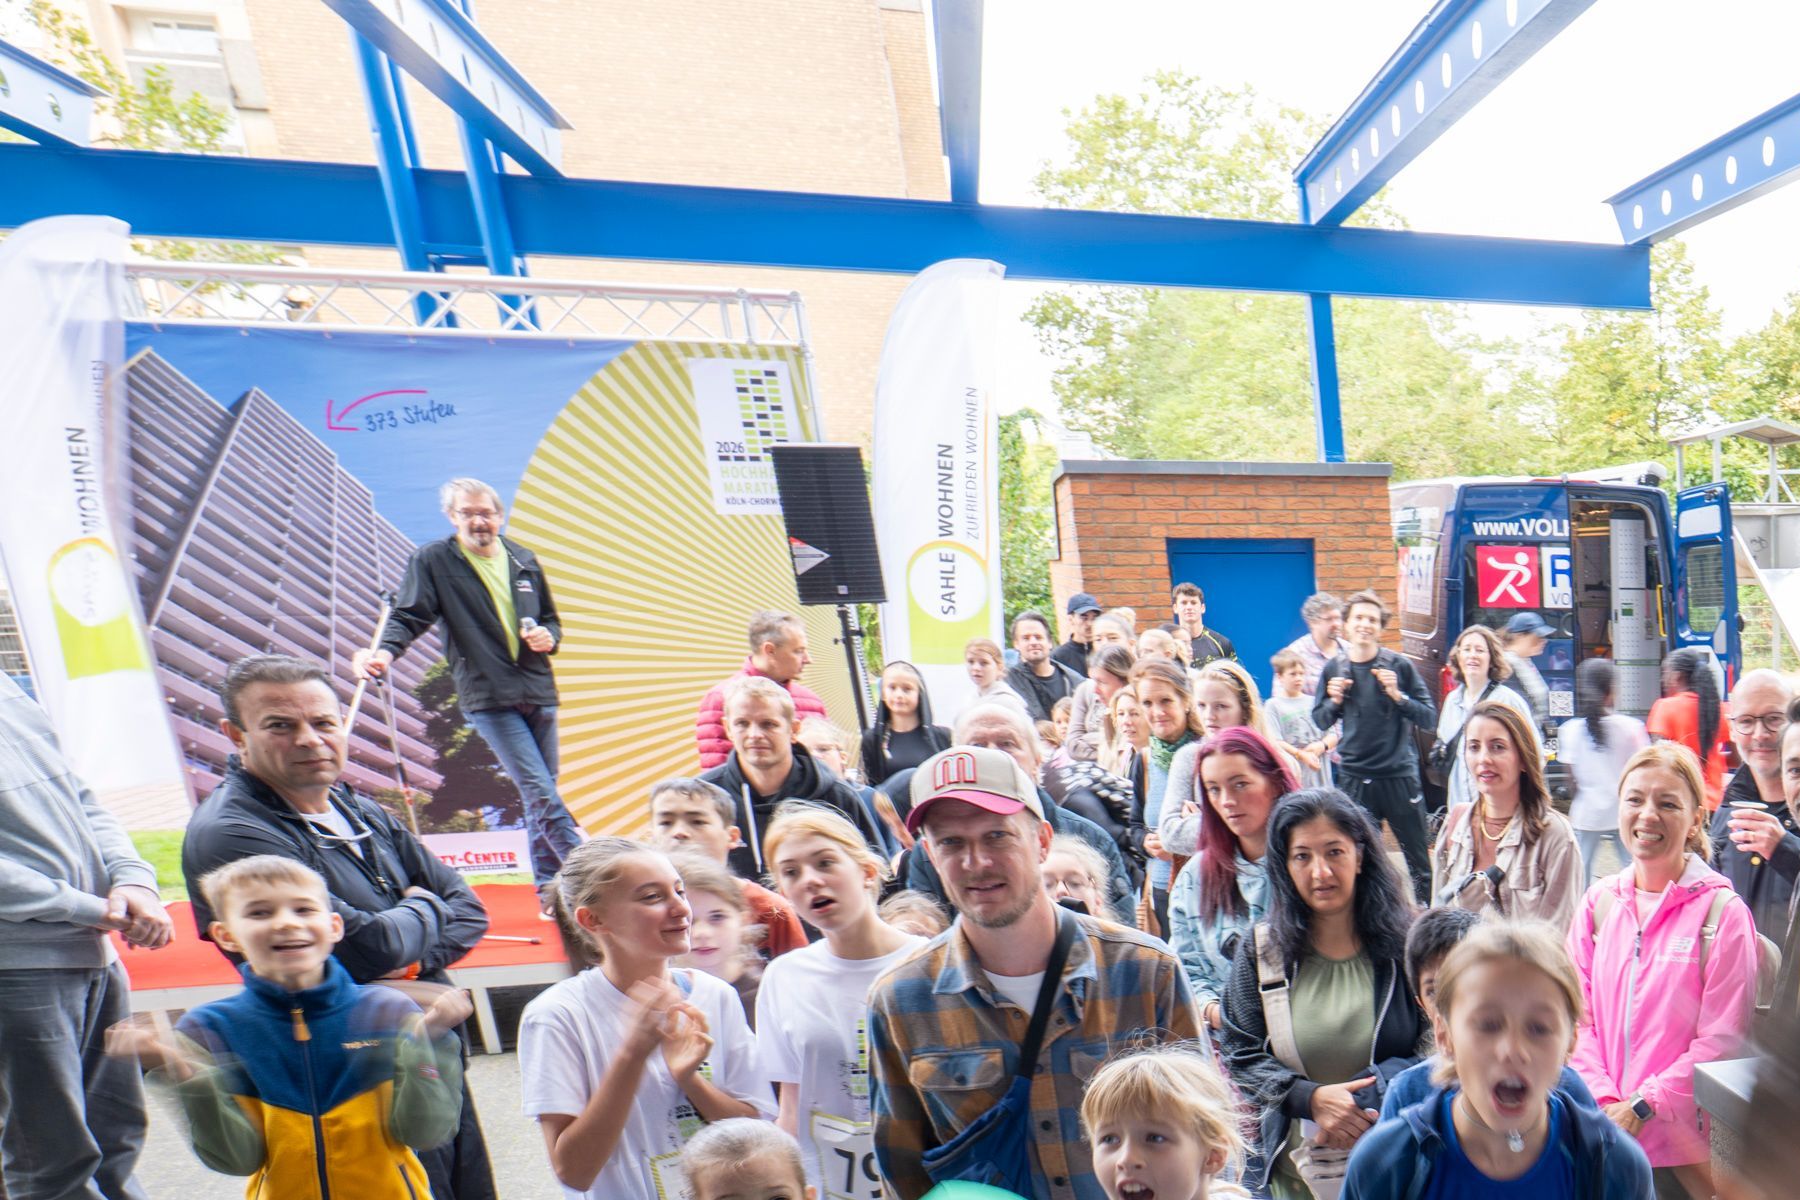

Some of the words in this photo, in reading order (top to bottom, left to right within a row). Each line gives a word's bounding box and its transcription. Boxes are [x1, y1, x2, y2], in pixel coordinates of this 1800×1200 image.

[365, 410, 398, 432] 373
[403, 400, 457, 424] Stufen
[716, 441, 745, 454] 2026
[965, 387, 978, 455] WOHNEN
[65, 427, 103, 535] WOHNEN
[937, 444, 955, 537] WOHNEN
[965, 460, 979, 540] ZUFRIEDEN
[939, 552, 956, 615] SAHLE
